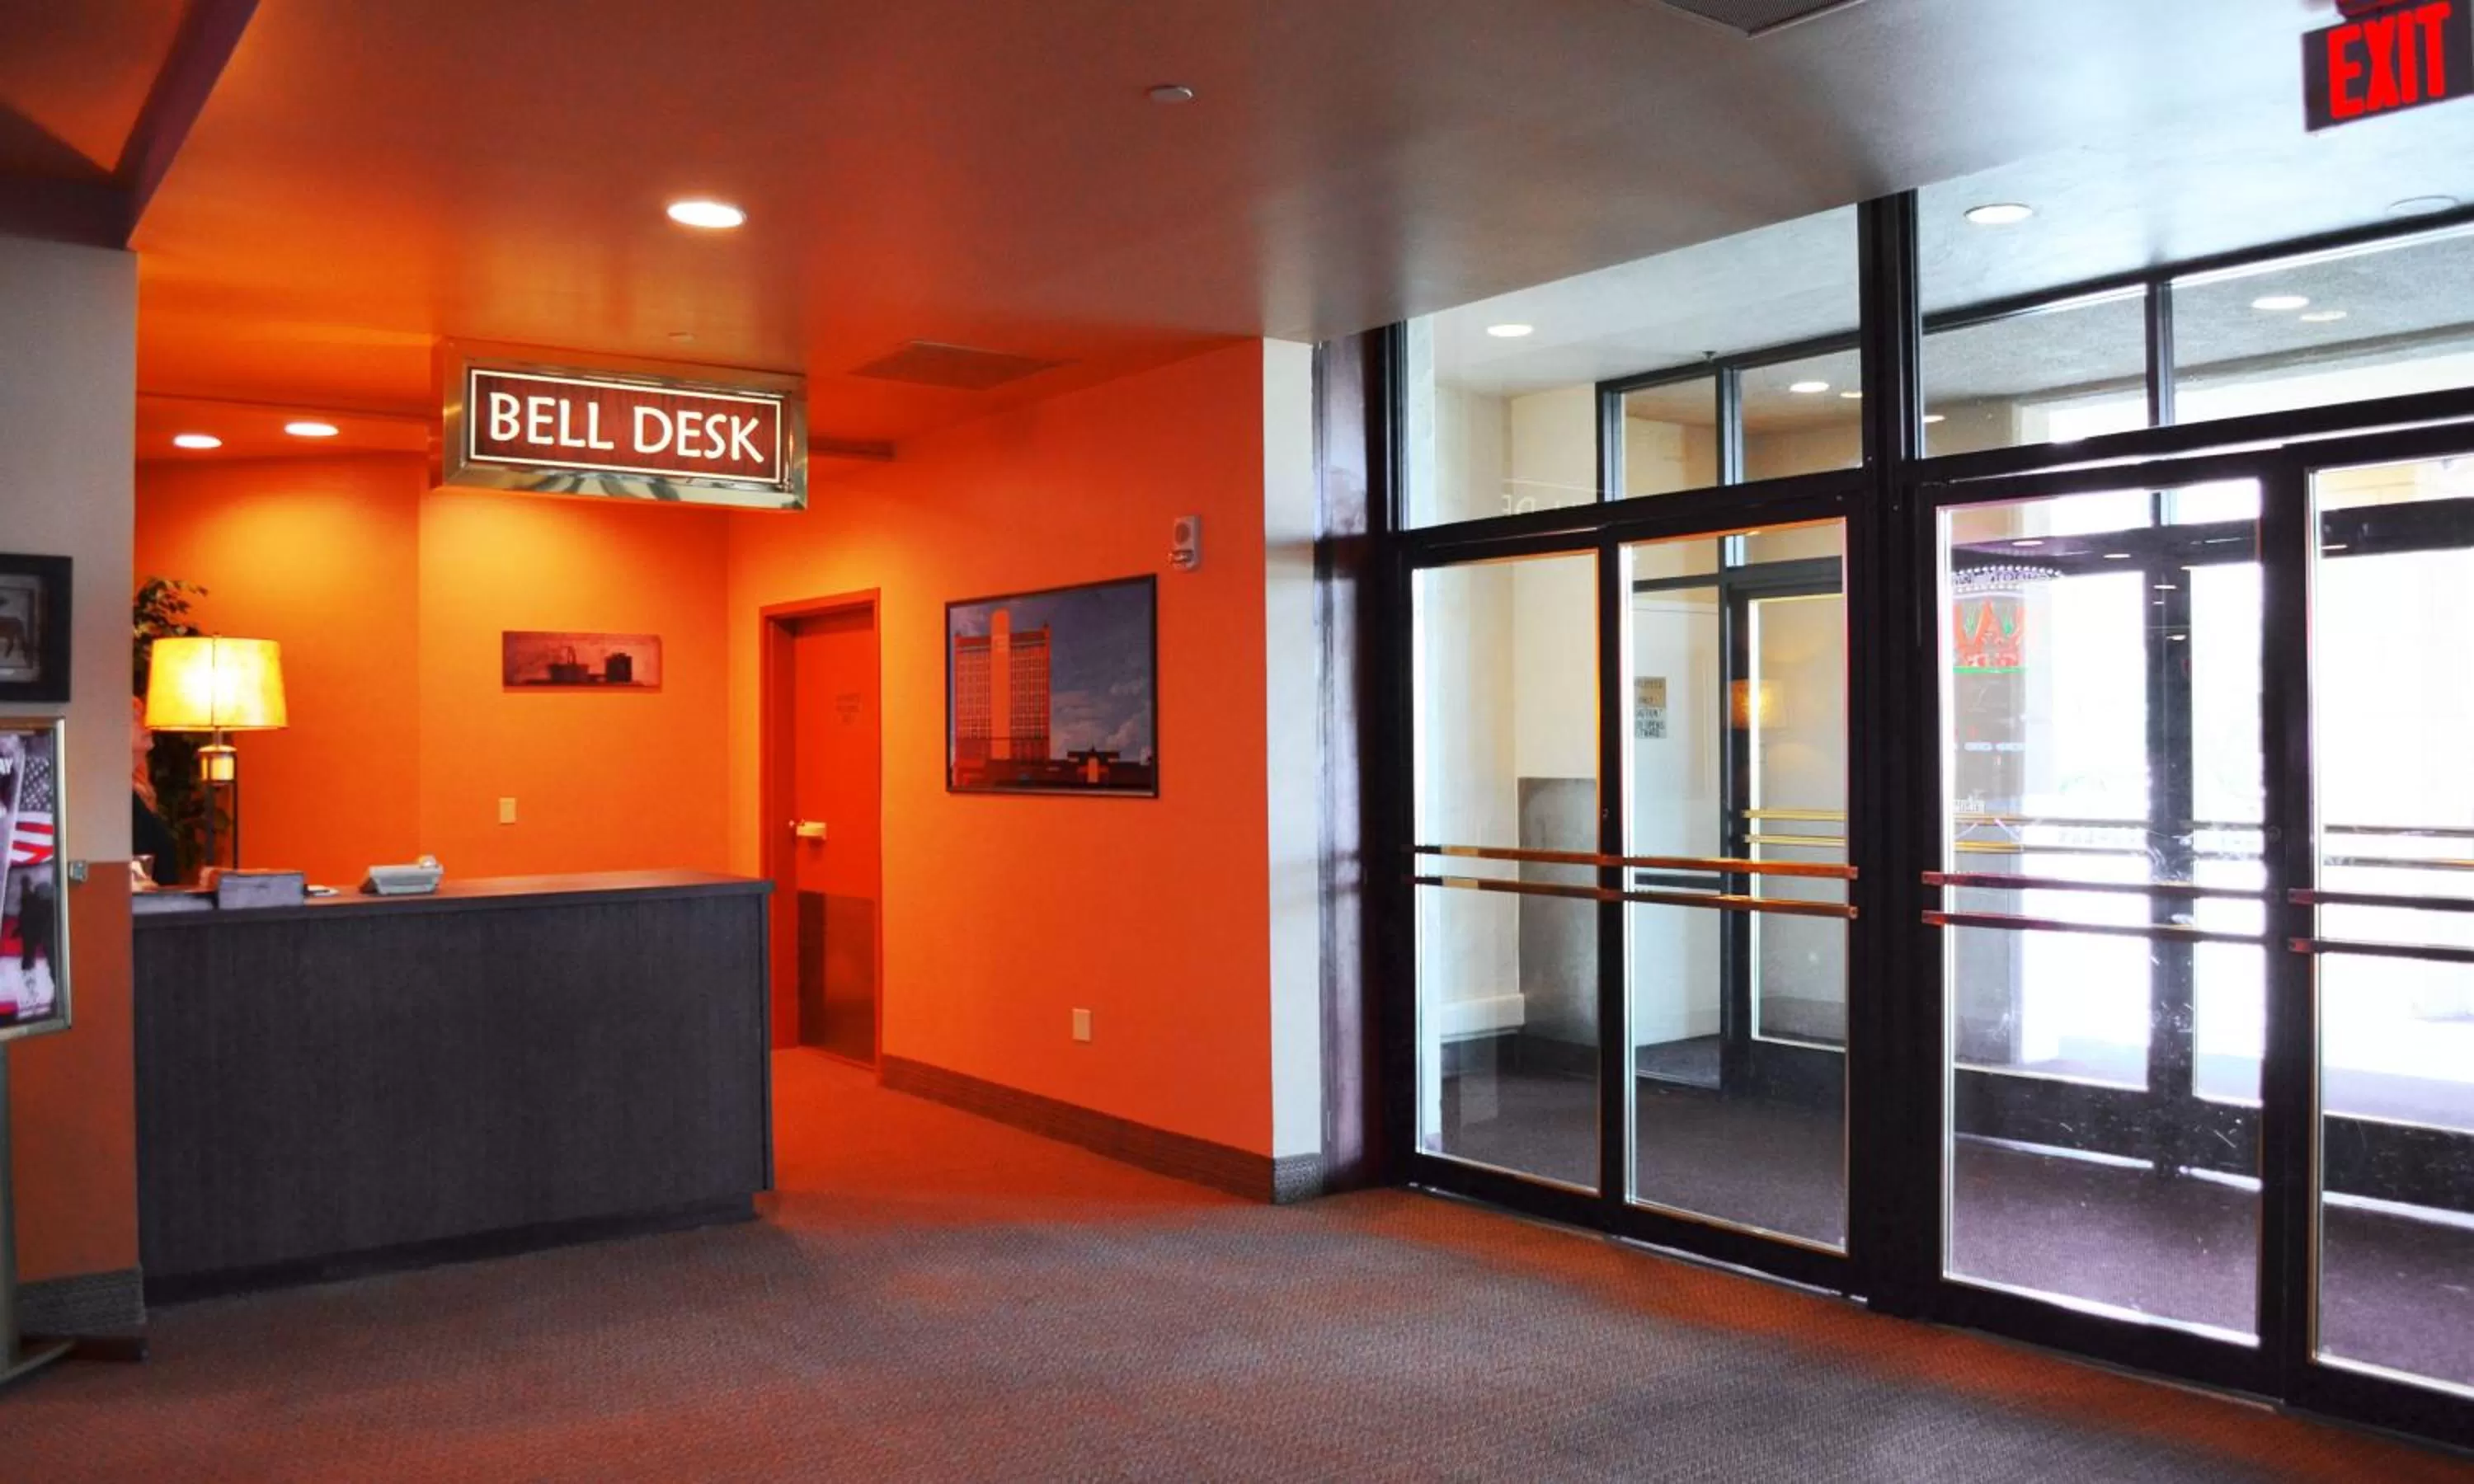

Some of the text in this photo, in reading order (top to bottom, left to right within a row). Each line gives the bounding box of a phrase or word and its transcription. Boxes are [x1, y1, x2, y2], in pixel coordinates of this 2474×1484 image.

[2327, 1, 2452, 120] EXIT
[489, 392, 764, 463] BELL DESK
